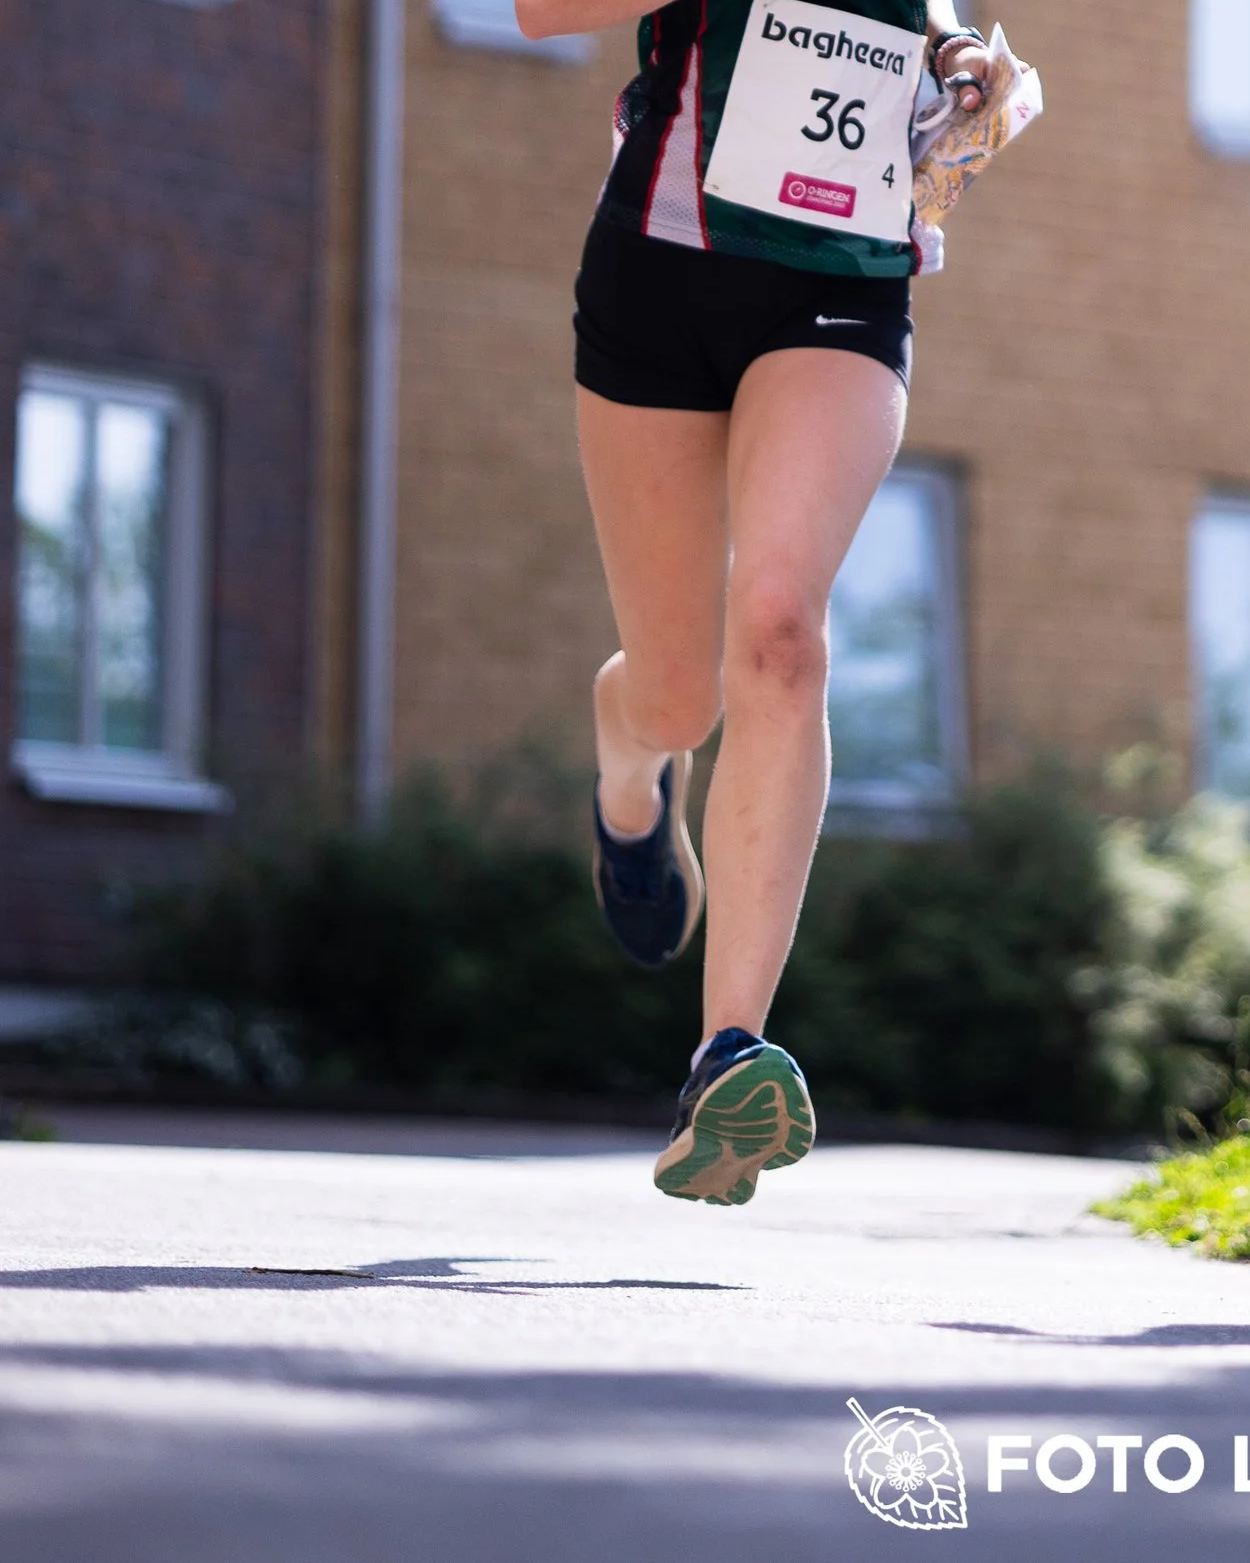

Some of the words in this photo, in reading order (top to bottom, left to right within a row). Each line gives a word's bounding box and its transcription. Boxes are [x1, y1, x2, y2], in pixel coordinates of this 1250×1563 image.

[761, 12, 905, 75] bagheera
[800, 88, 866, 150] 36
[807, 185, 852, 204] O-RINGEN
[881, 163, 895, 189] 4
